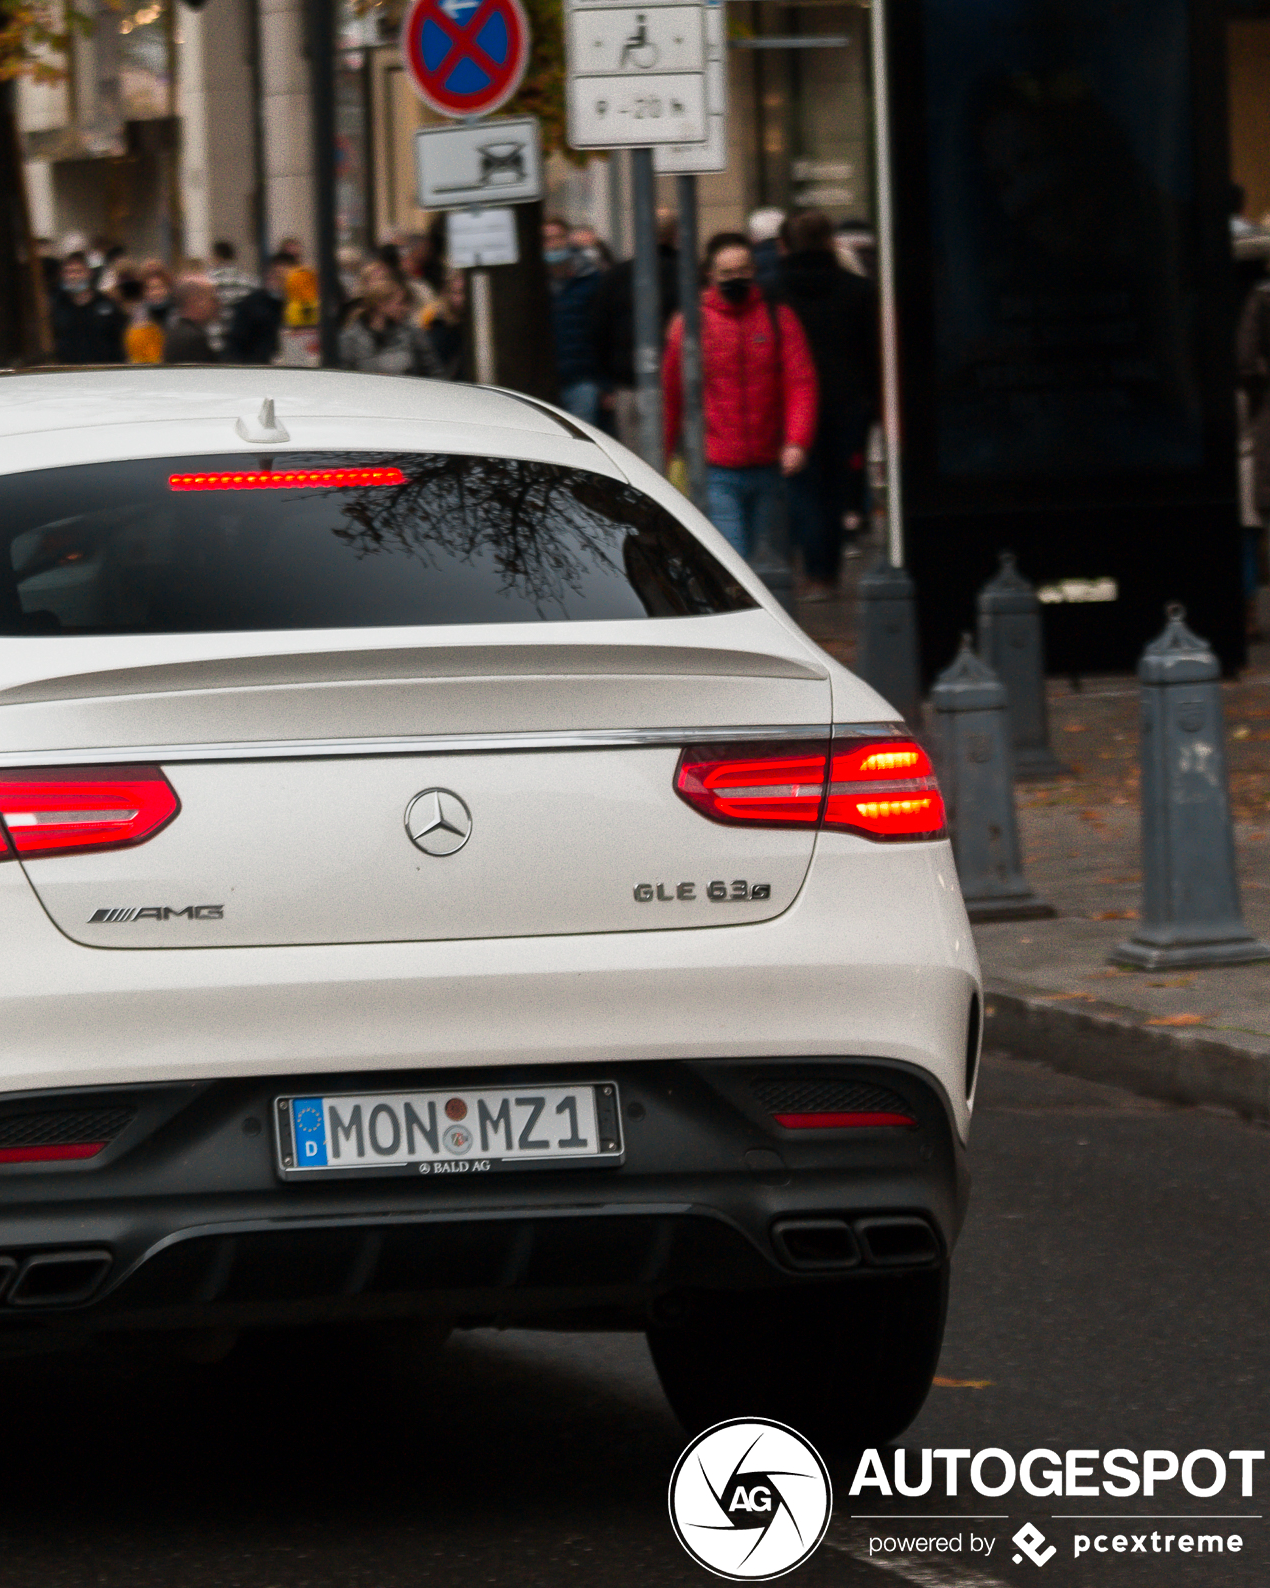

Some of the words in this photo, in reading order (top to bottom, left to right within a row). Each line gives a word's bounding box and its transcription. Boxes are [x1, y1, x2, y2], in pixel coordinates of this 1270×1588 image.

[633, 882, 697, 902] GLE
[129, 905, 225, 922] AMG
[328, 1101, 441, 1158] MON
[477, 1096, 589, 1151] MZ1
[304, 1140, 318, 1157] D
[433, 1162, 470, 1175] BALD
[471, 1160, 492, 1173] AG
